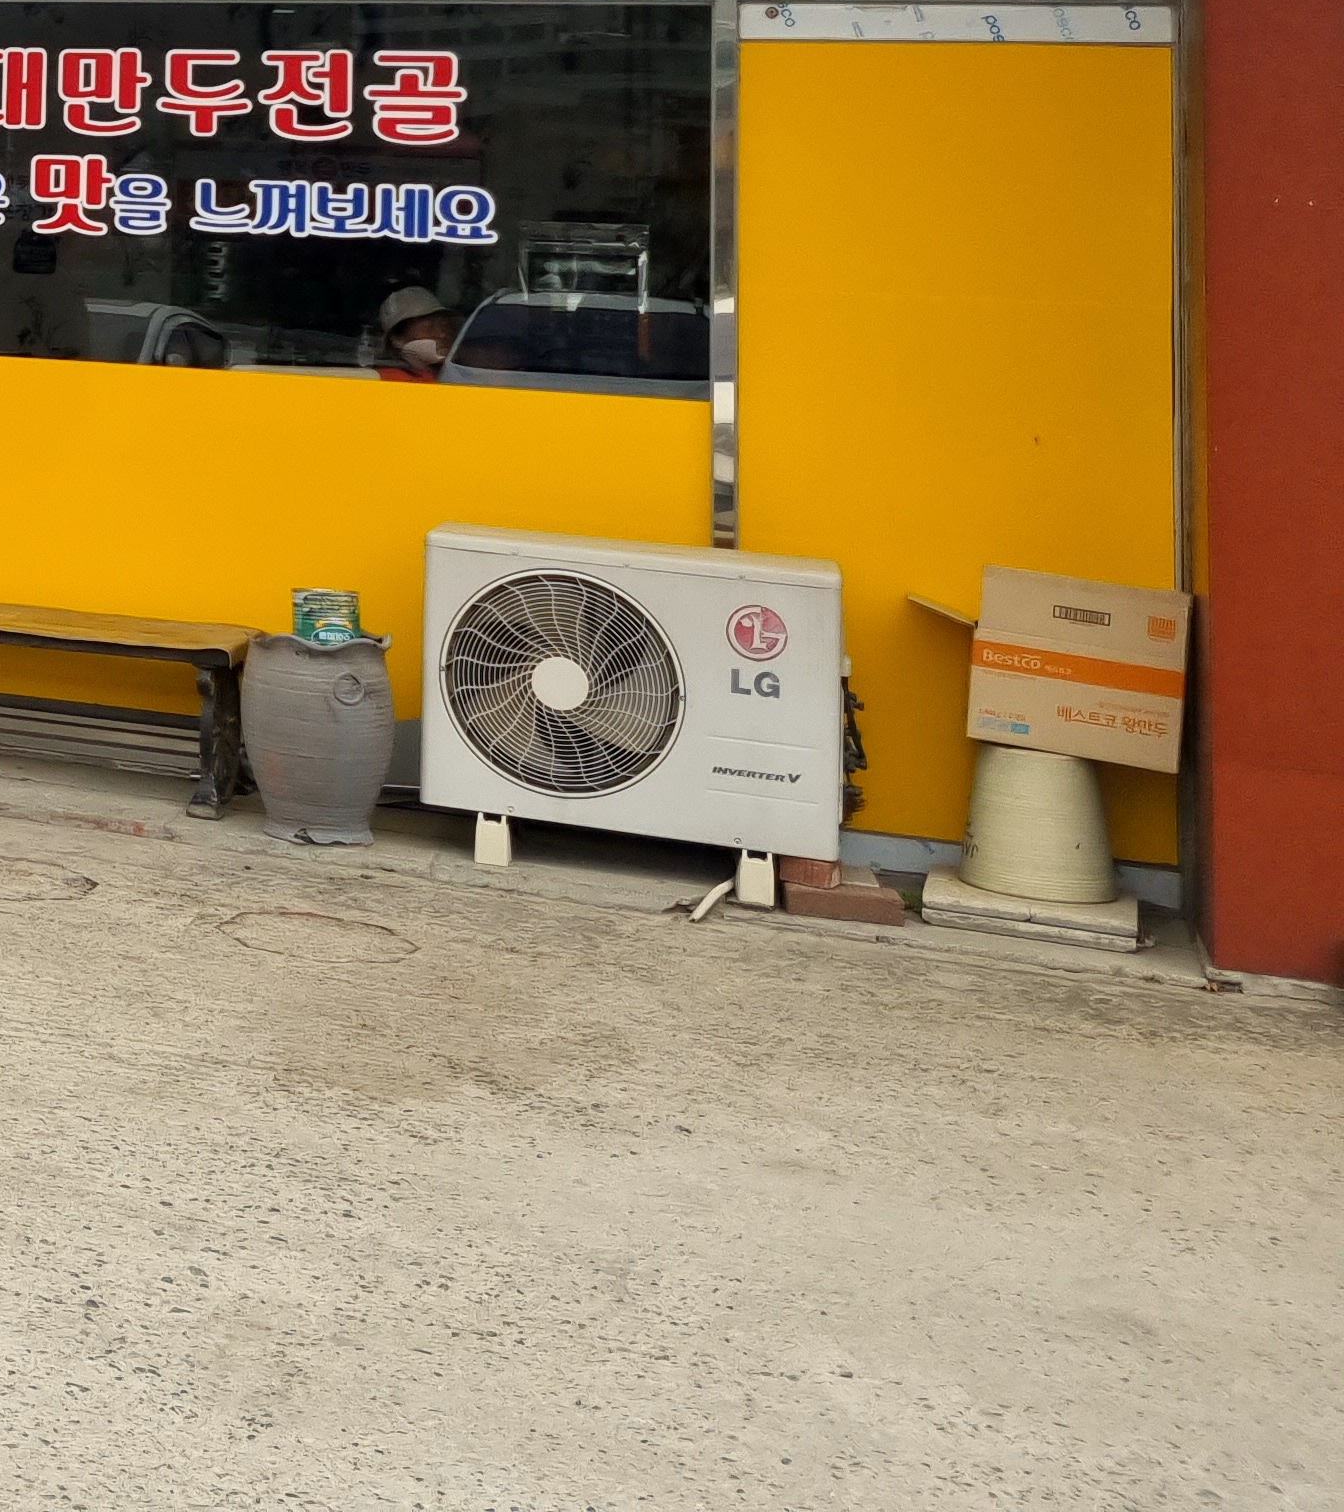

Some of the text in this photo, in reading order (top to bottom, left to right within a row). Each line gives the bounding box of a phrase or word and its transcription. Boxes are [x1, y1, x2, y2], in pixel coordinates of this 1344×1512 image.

[30, 152, 171, 236] 맛을
[189, 178, 498, 246] 느껴보세요
[731, 668, 780, 699] LG
[712, 766, 786, 783] INVERTER
